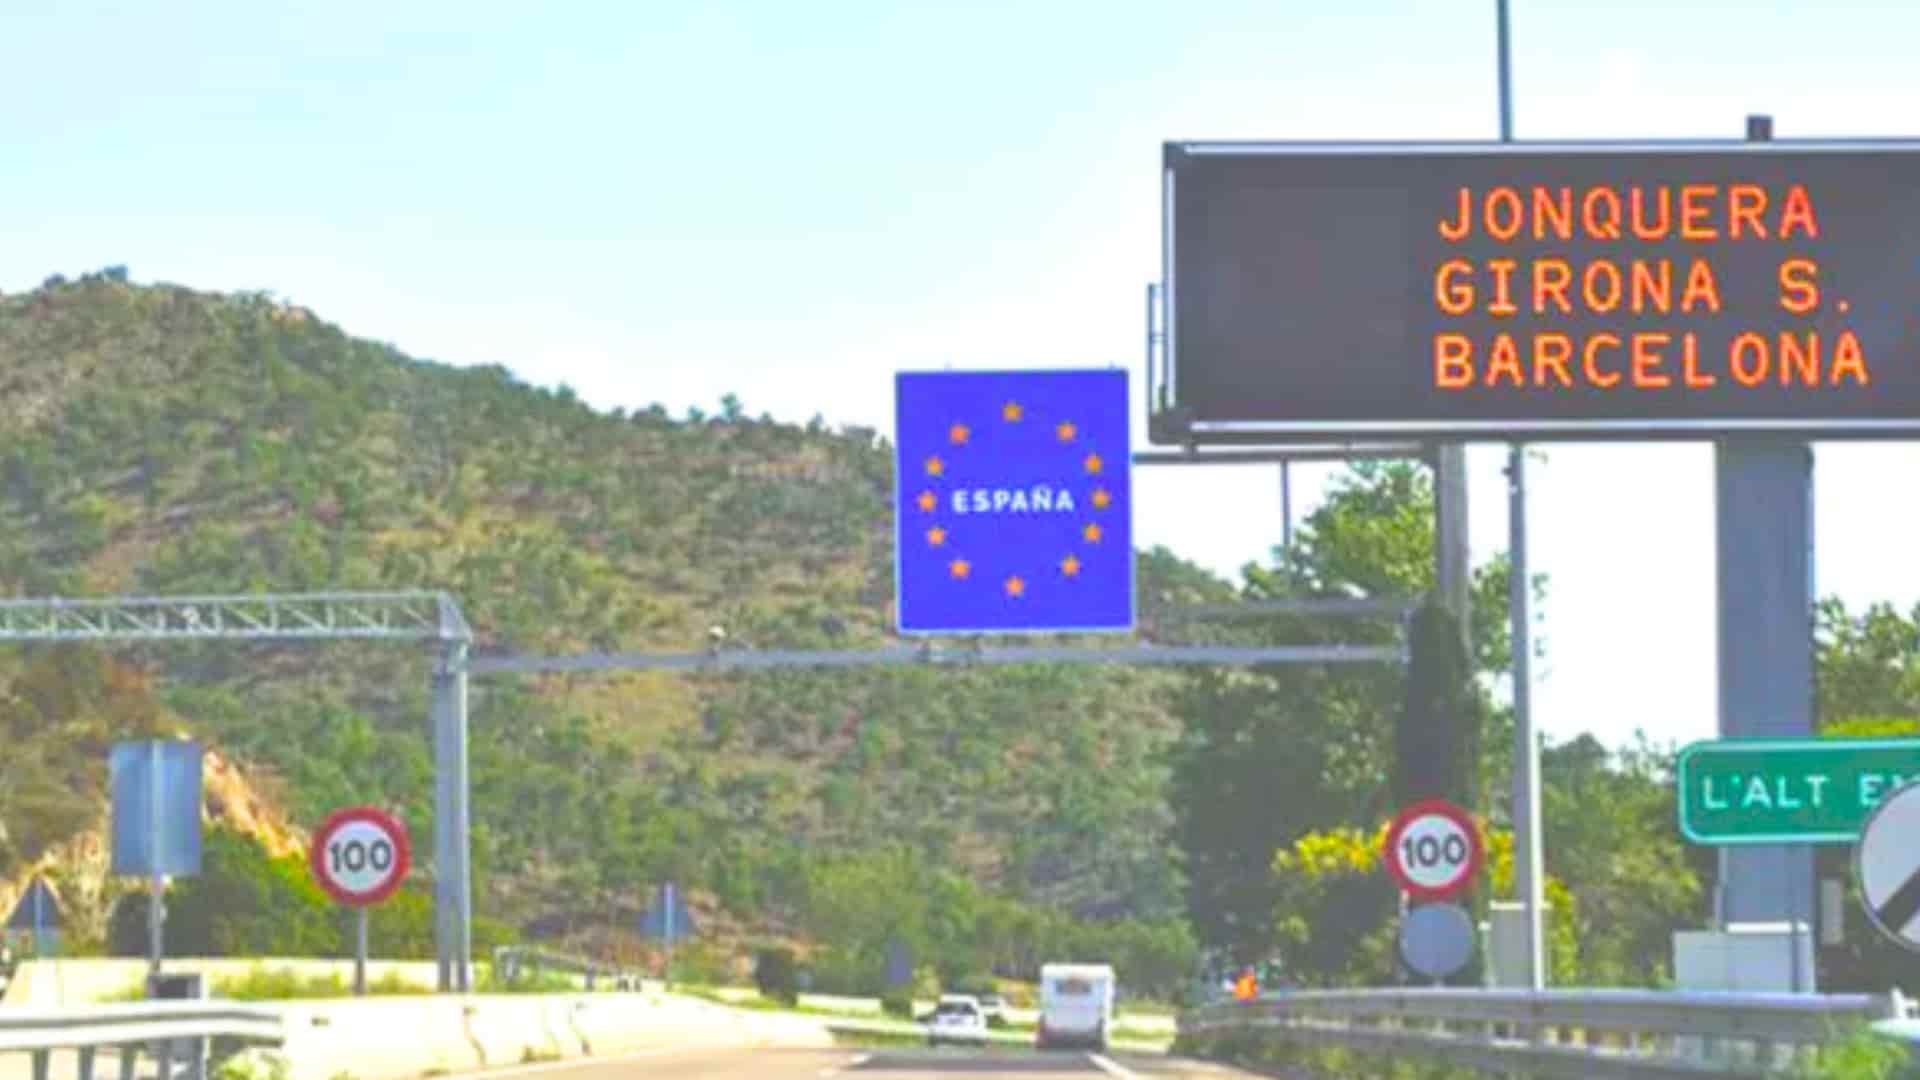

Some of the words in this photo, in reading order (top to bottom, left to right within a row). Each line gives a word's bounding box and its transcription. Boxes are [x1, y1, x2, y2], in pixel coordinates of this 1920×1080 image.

[1438, 184, 1819, 241] JONQUERA
[1434, 257, 1721, 315] GIRONA
[1778, 257, 1850, 315] S.
[1434, 332, 1870, 388] BARCELONA
[952, 484, 1075, 514] ESPAÑA
[1702, 774, 1830, 810] L'ALT
[328, 839, 391, 873] 100
[1403, 832, 1466, 869] 100
